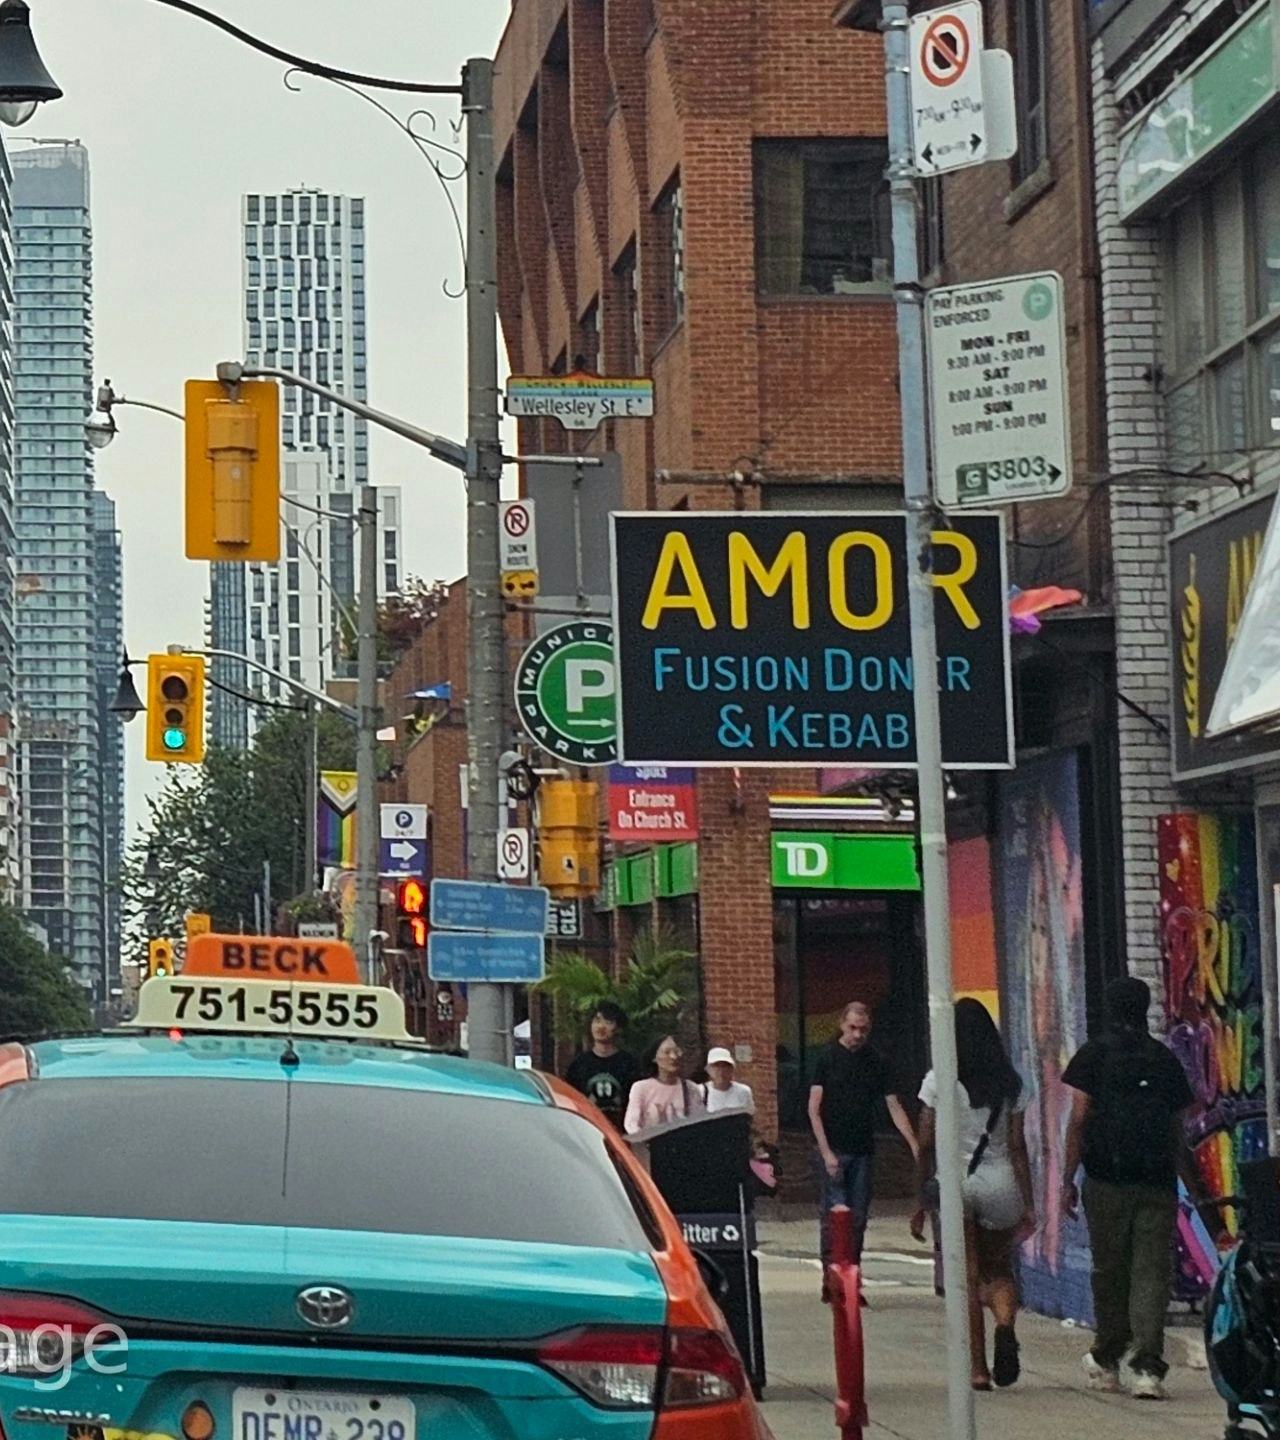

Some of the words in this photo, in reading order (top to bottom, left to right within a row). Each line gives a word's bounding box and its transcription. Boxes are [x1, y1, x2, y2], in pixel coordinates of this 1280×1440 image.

[955, 289, 1005, 307] PARKING
[933, 308, 990, 328] ENFORCED
[961, 336, 994, 350] MON
[1006, 330, 1030, 344] FRI
[973, 352, 991, 365] AM
[1027, 344, 1045, 358] PM
[983, 366, 1010, 381] SAT
[975, 386, 993, 399] AM
[1028, 378, 1047, 392] PM
[522, 398, 596, 418] Wellesley
[983, 401, 1013, 415] SUN
[975, 420, 993, 433] PM
[1028, 412, 1046, 427] PM
[988, 456, 1047, 481] 3803
[641, 531, 981, 631] AMOR
[654, 648, 809, 692] FUSION
[824, 648, 971, 692] DONR
[718, 704, 754, 748] &
[767, 705, 909, 749] KEBAB
[629, 789, 676, 808] Entrance
[618, 811, 633, 828] On
[634, 811, 672, 828] Church
[673, 811, 688, 829] St.
[776, 841, 829, 877] TD
[222, 942, 328, 975] BECK
[170, 985, 378, 1028] 751-5555
[683, 1222, 719, 1243] itter
